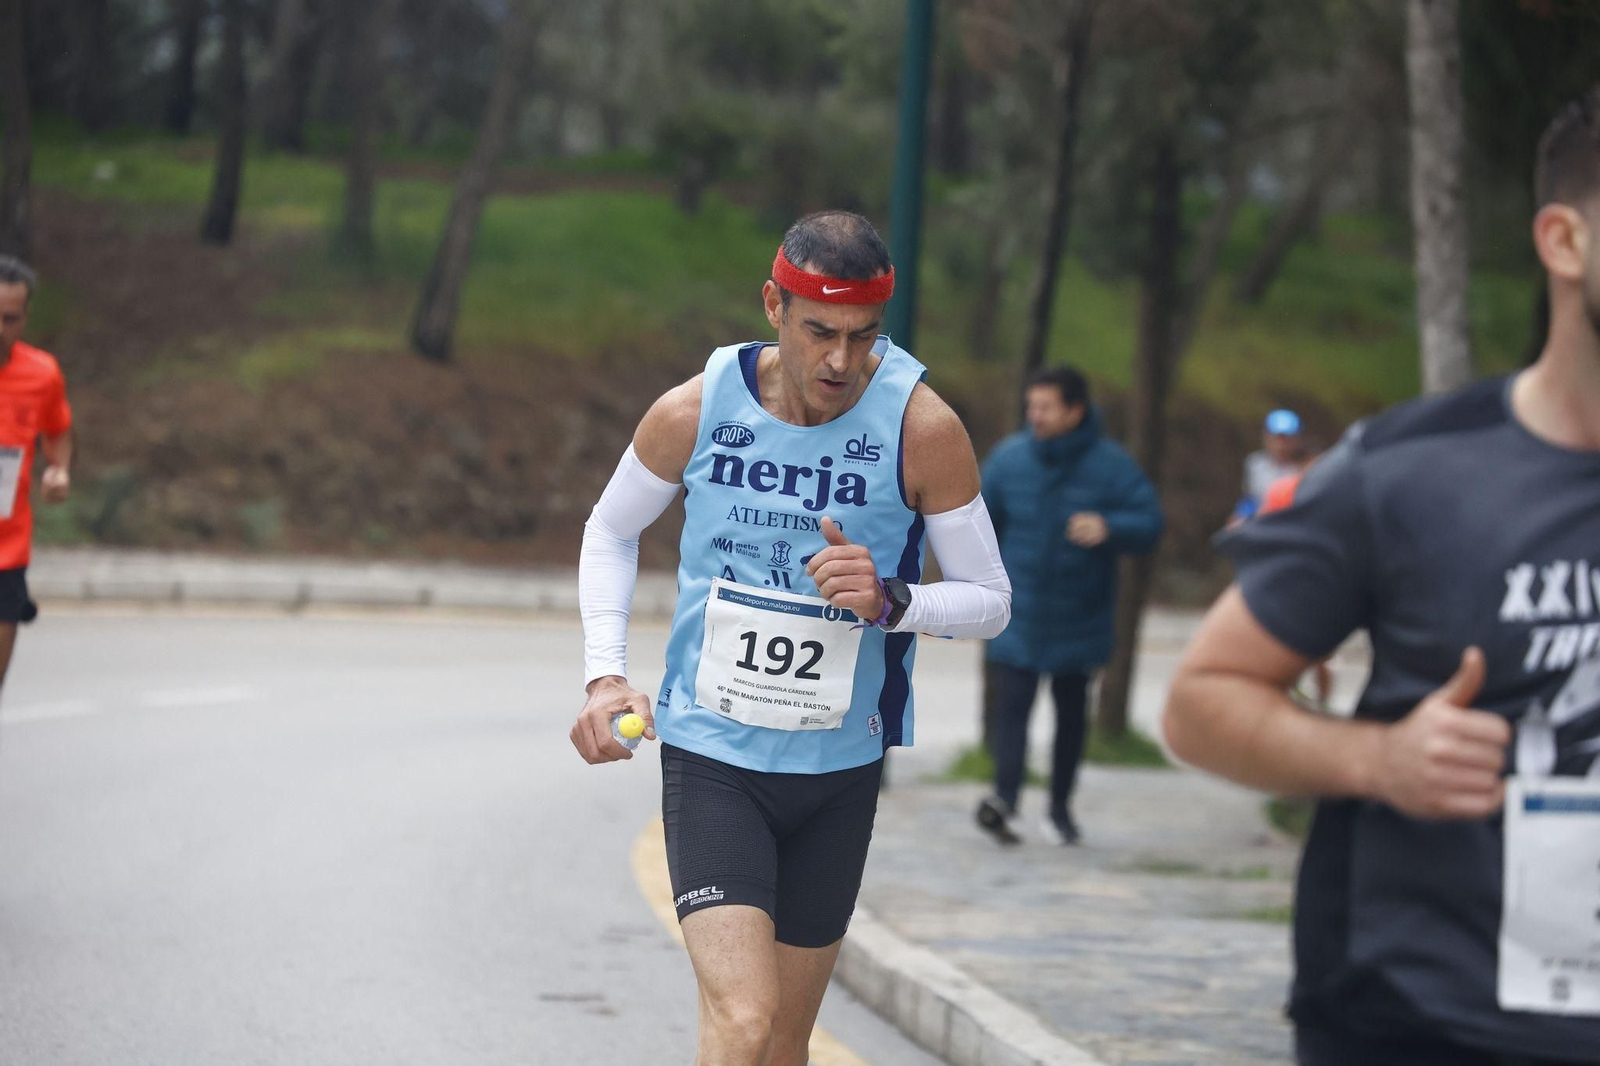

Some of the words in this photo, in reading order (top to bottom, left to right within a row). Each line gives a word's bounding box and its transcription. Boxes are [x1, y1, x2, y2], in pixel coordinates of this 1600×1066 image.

[713, 426, 753, 444] TROPS
[843, 433, 881, 462] als
[708, 453, 868, 512] nerja
[735, 542, 759, 551] metro
[729, 592, 801, 612] www.deporte.malaga.eu
[736, 631, 824, 681] 192
[733, 677, 755, 688] MARCOS
[755, 683, 787, 693] GUARDIOLA
[726, 687, 740, 697] MINI
[740, 692, 773, 704] MARATÓN
[773, 697, 792, 707] PEÑA
[803, 703, 831, 712] BASTÓN
